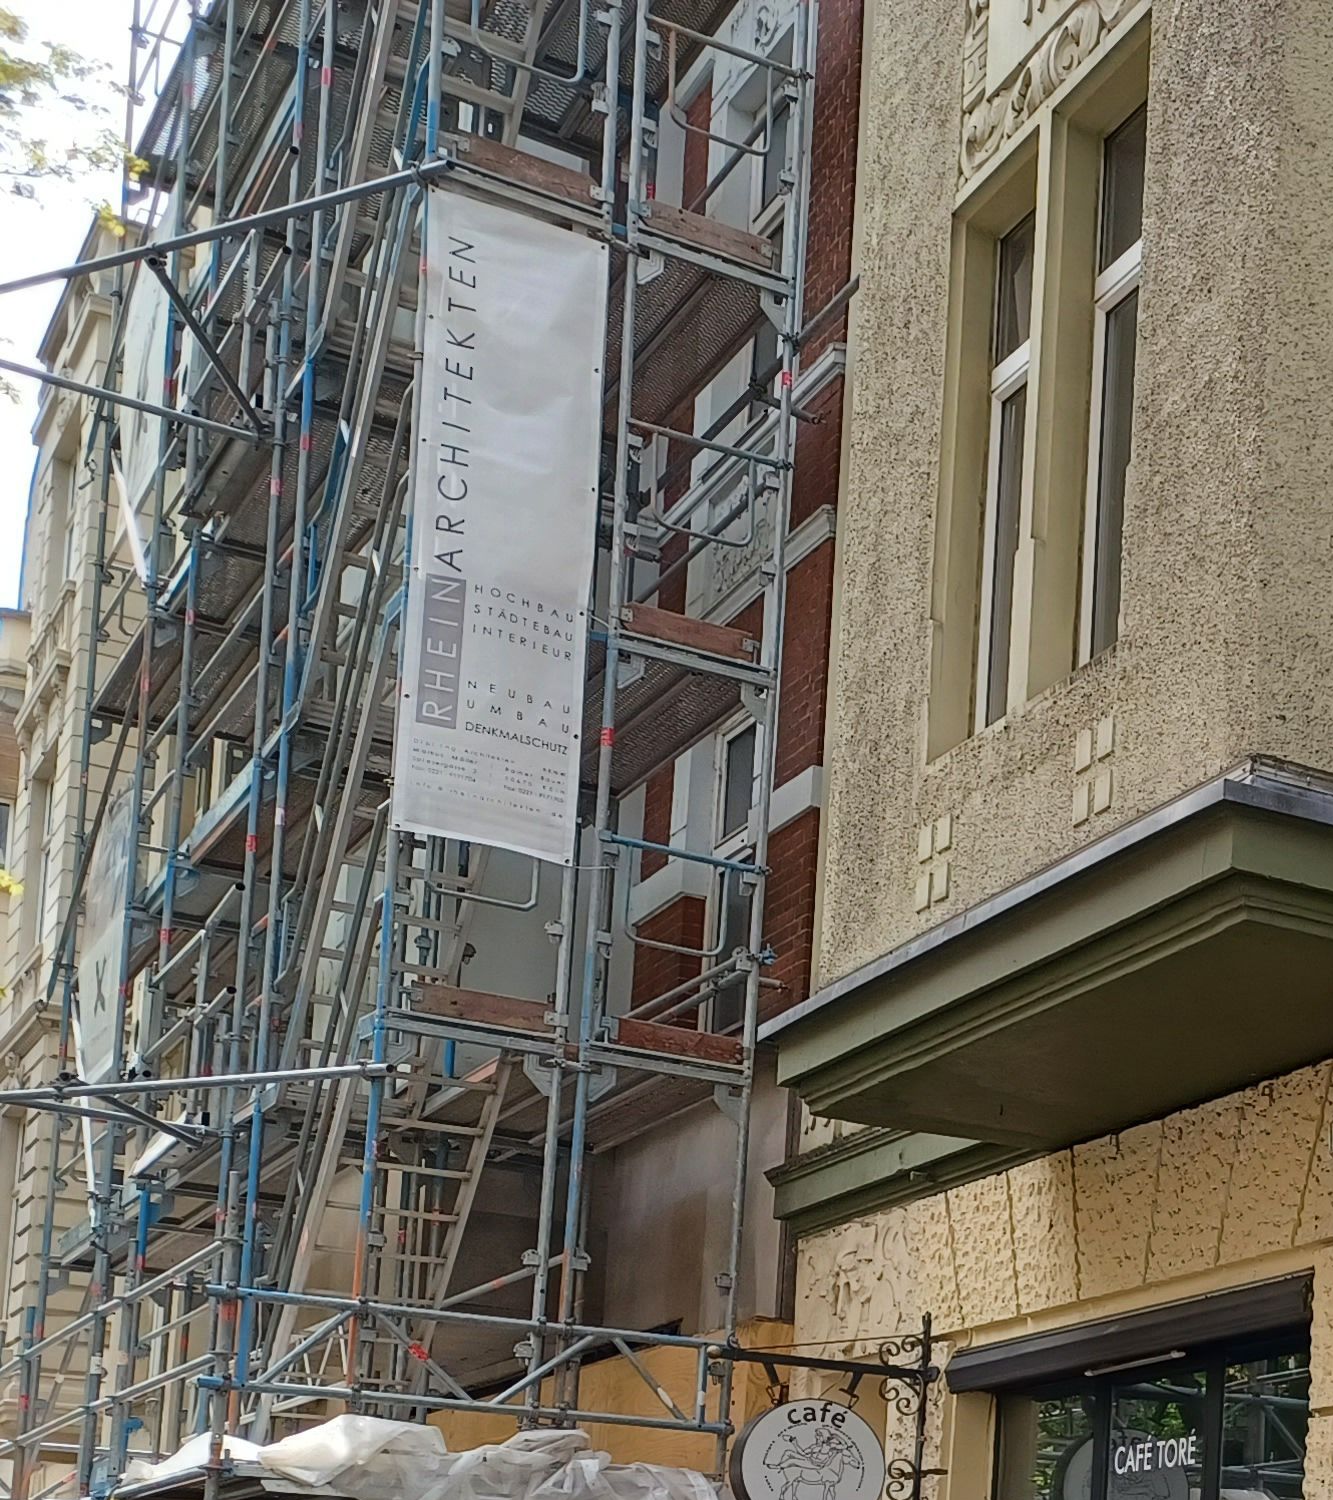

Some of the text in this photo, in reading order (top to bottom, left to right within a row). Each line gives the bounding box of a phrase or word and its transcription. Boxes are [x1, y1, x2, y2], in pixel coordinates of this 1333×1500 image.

[473, 584, 574, 623] HOCHBAU
[473, 604, 573, 642] STÄDTEBAU
[472, 624, 572, 661] INTERIEUR
[467, 680, 571, 714] NEUBAU
[466, 699, 569, 734] UMBAU
[465, 721, 569, 756] DENKMALSCHUTZ
[787, 1403, 849, 1429] café
[1114, 1428, 1196, 1475] CAFÉ TORÉ
